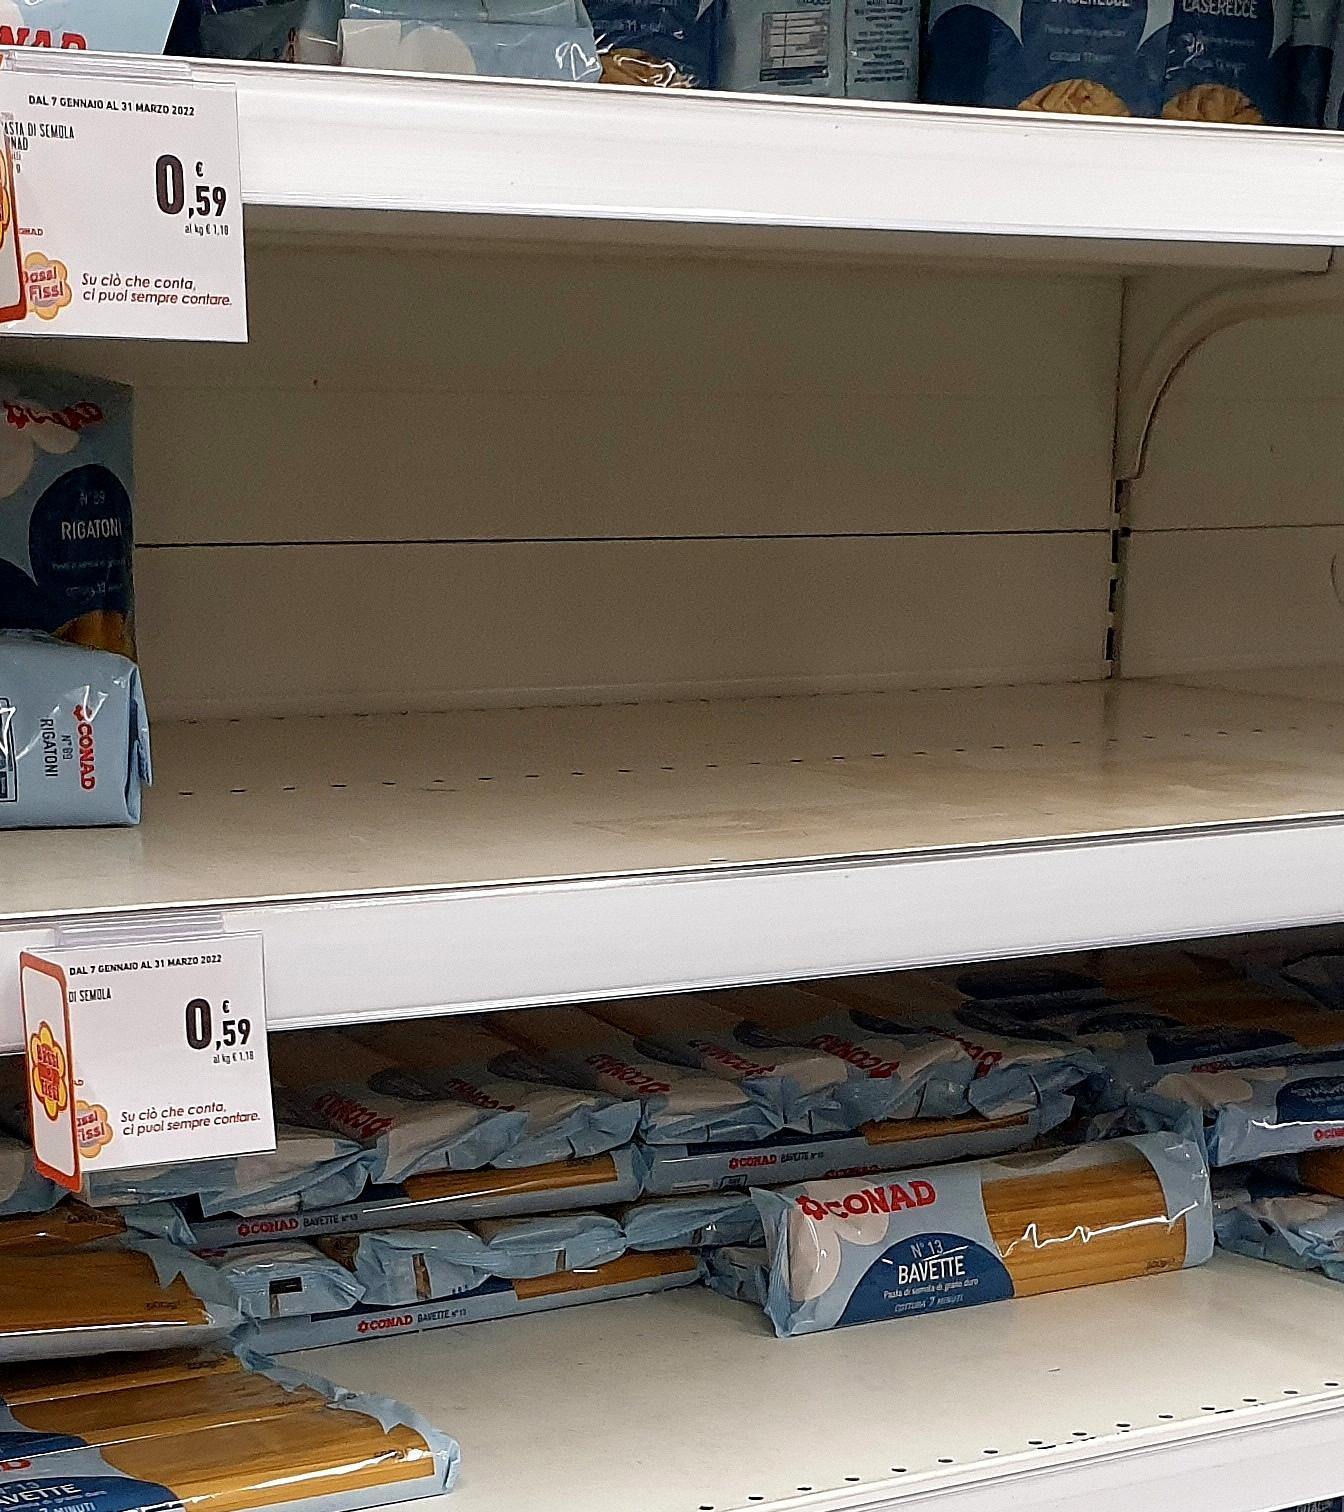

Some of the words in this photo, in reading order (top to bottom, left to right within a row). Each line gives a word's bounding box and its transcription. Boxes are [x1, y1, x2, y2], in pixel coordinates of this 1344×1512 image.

[28, 94, 49, 107] DAL
[52, 96, 58, 107] 7
[60, 97, 104, 110] GENNAIO
[106, 99, 119, 112] AL
[122, 101, 133, 112] 31
[136, 103, 170, 115] MARZO
[172, 105, 195, 117] 2022
[1, 121, 25, 137] ASTA
[40, 125, 75, 139] SEMOLA
[156, 154, 227, 219] 0,59
[196, 161, 204, 177] €
[82, 273, 97, 285] Su
[101, 273, 121, 287] ciò
[125, 275, 150, 288] che
[154, 276, 197, 291] conta,
[83, 288, 95, 301] ci
[98, 289, 127, 304] puoi
[131, 291, 177, 305] sempre
[181, 293, 233, 306] contare.
[61, 518, 121, 541] RIGATONI
[40, 718, 58, 778] RIGATONI
[78, 722, 96, 790] CONAD
[69, 966, 88, 976] DAL
[90, 965, 96, 974] 7
[98, 962, 139, 974] GENNAIO
[140, 960, 154, 970] AL
[155, 959, 166, 969] 31
[167, 957, 199, 968] MARZO
[200, 954, 223, 965] 2022
[79, 988, 112, 1002] SEMOLA
[185, 998, 251, 1050] 0,59
[223, 1000, 230, 1013] €
[121, 1111, 135, 1123] Su
[138, 1107, 158, 1121] ciò
[161, 1106, 185, 1118] che
[187, 1102, 226, 1116] conta,
[123, 1123, 136, 1136] ci
[137, 1120, 165, 1136] puoi
[167, 1117, 211, 1131] sempre
[213, 1112, 261, 1127] contare.
[739, 1155, 777, 1168] CONAD
[825, 1181, 936, 1219] CONAD
[250, 1219, 299, 1233] CONAD
[910, 1241, 927, 1258] N°
[928, 1240, 944, 1255] 13
[898, 1256, 966, 1285] BAVETTE
[370, 1315, 413, 1328] CONAD
[417, 1311, 449, 1322] BAVETTE
